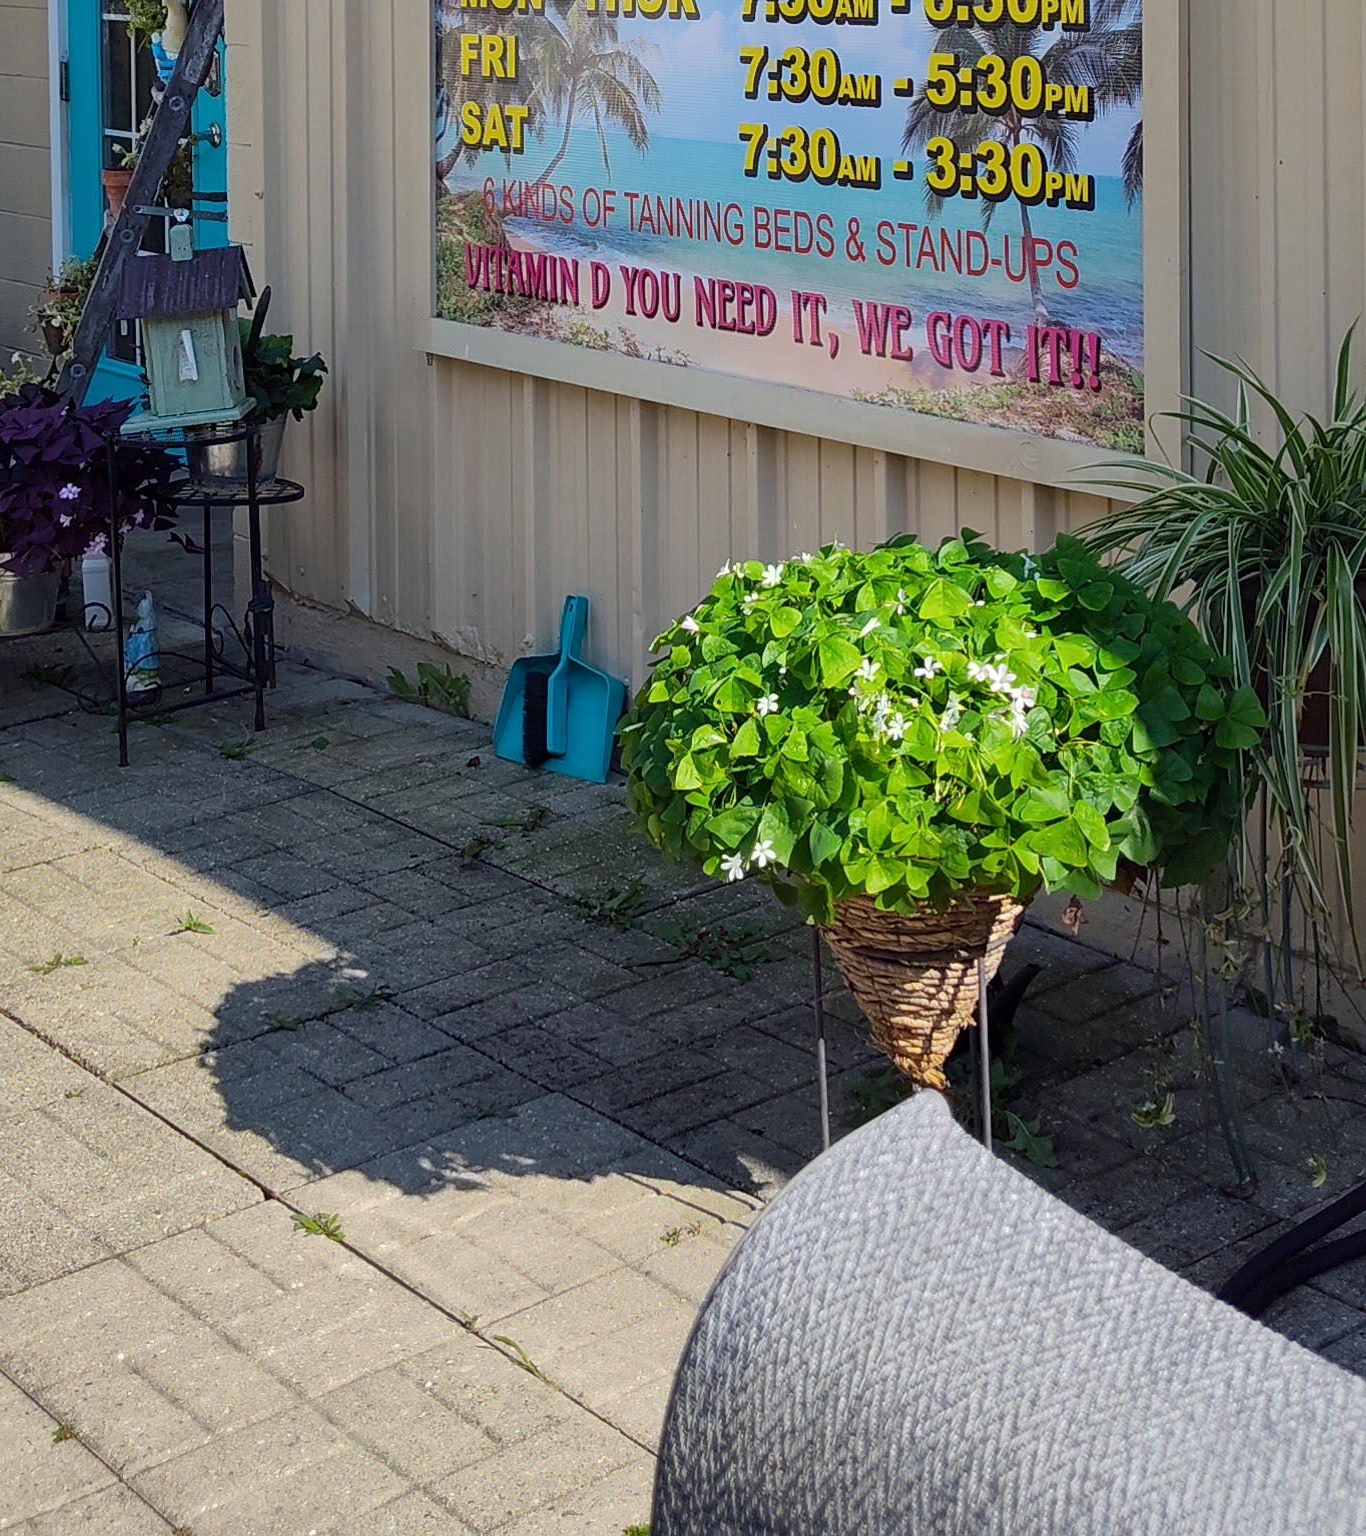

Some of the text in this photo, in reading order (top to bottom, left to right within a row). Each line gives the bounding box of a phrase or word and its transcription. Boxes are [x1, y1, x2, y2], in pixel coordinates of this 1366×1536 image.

[460, 34, 1093, 121] FRI 7:30AM - 5:30PM
[461, 101, 1094, 210] SAT 7:30AM - 3:30PM
[483, 177, 1079, 290] 6 KINDS OF TANNING BEDS & STAND-UPS
[465, 244, 1103, 392] VITAMIN D YOU NEED IT, WE GOT IT!!
